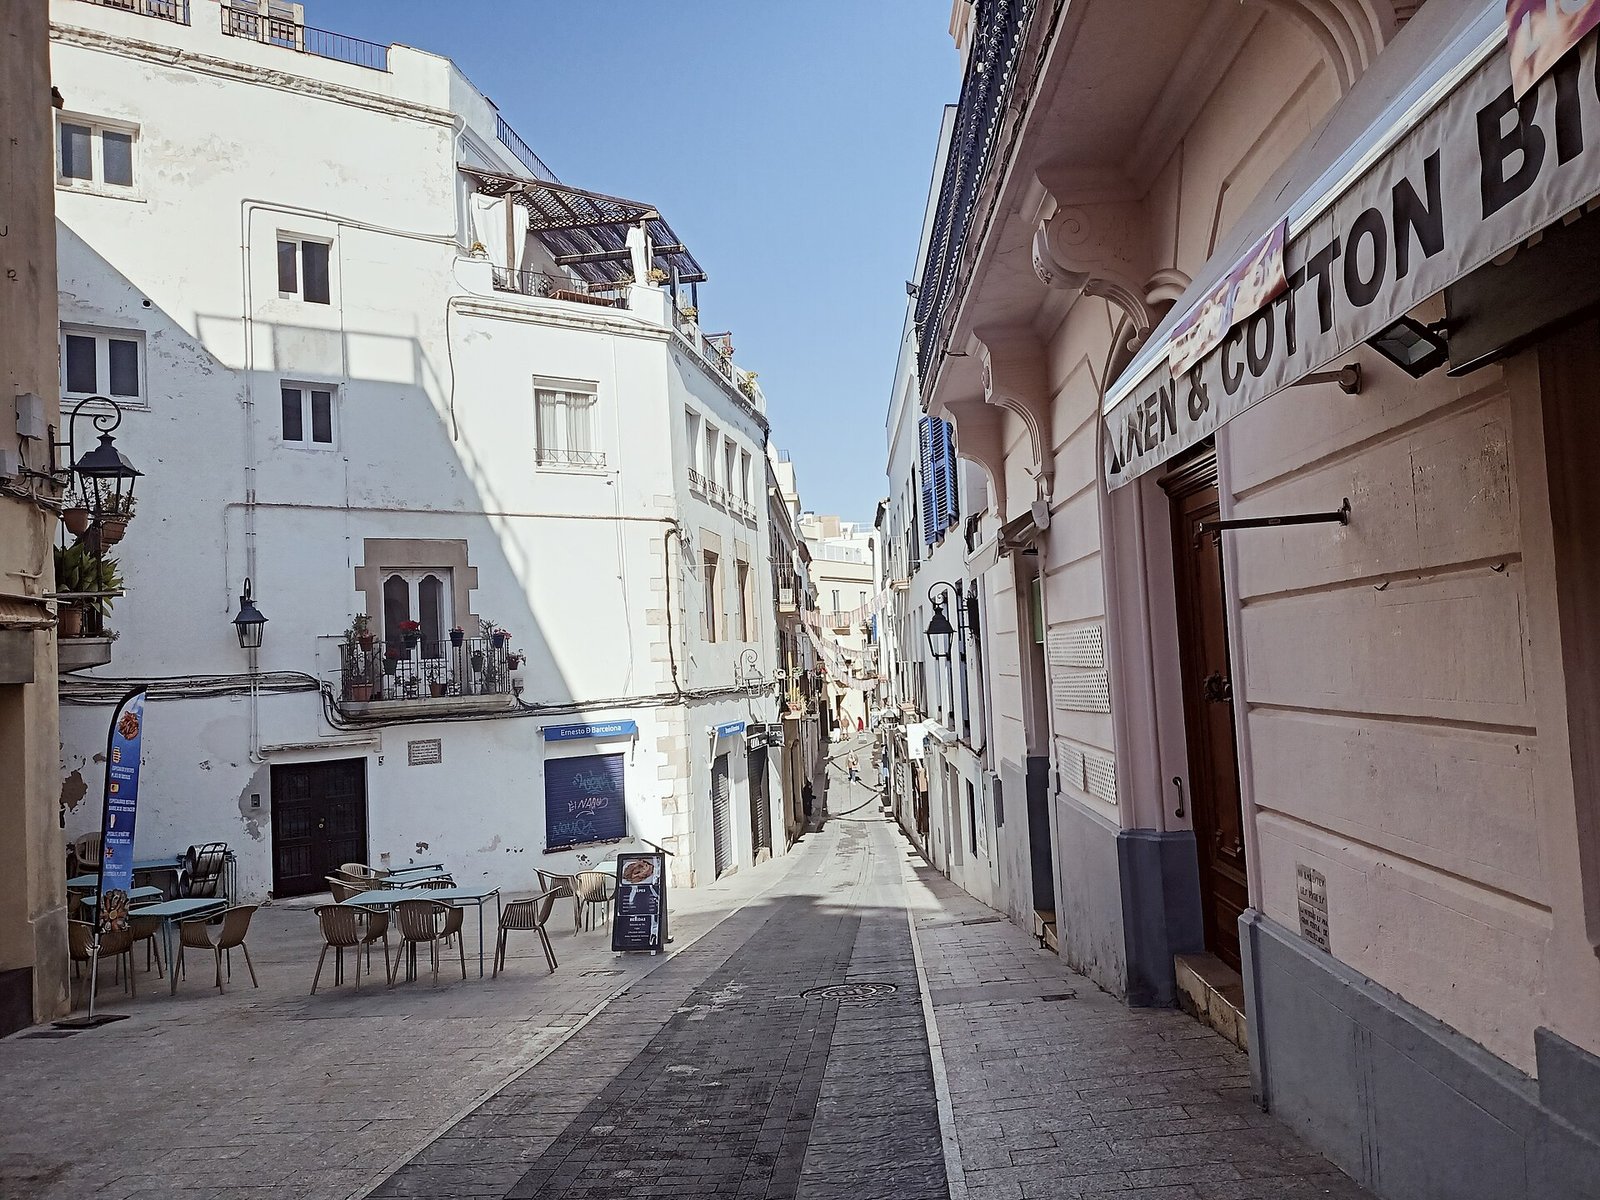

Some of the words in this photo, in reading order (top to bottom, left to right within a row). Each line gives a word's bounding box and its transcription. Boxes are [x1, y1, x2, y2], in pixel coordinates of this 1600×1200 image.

[1187, 363, 1210, 421] &
[1220, 148, 1447, 396] COTTON
[1475, 26, 1600, 221] BI
[560, 728, 585, 737] Ernesto
[591, 725, 622, 734] Barcelona
